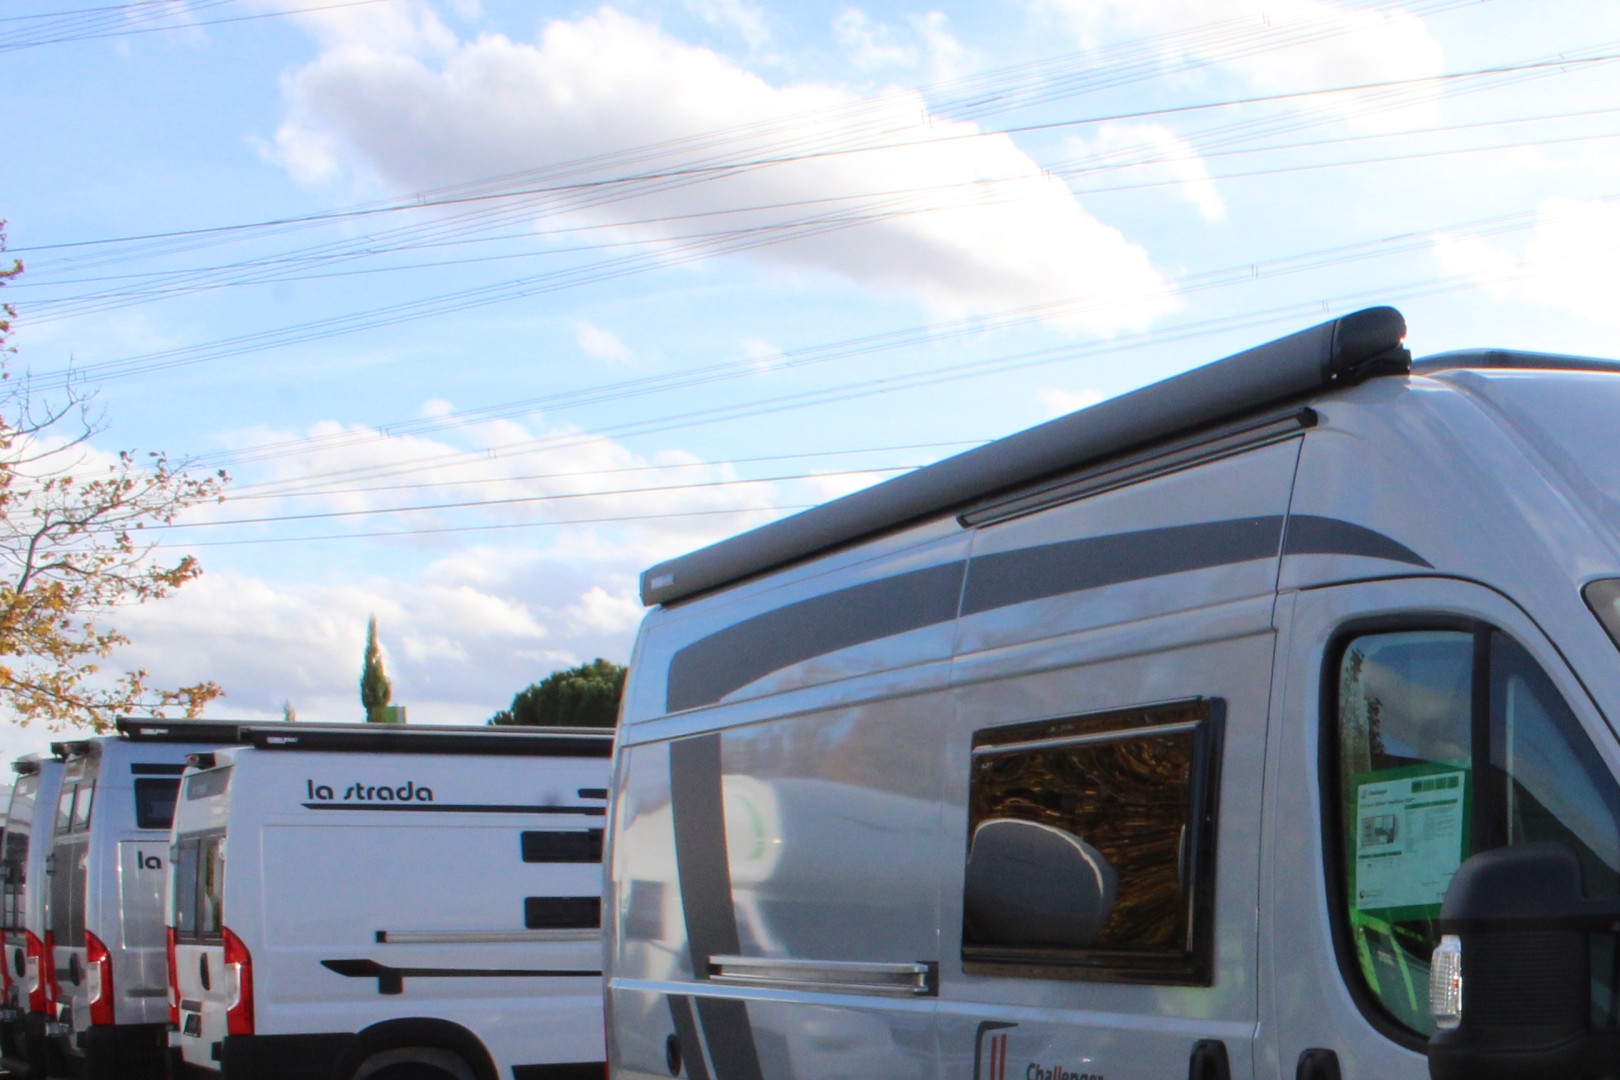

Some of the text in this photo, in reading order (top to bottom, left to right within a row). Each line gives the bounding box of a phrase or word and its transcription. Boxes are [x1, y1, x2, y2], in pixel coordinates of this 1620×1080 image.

[308, 779, 433, 802] la strada
[137, 851, 162, 870] la
